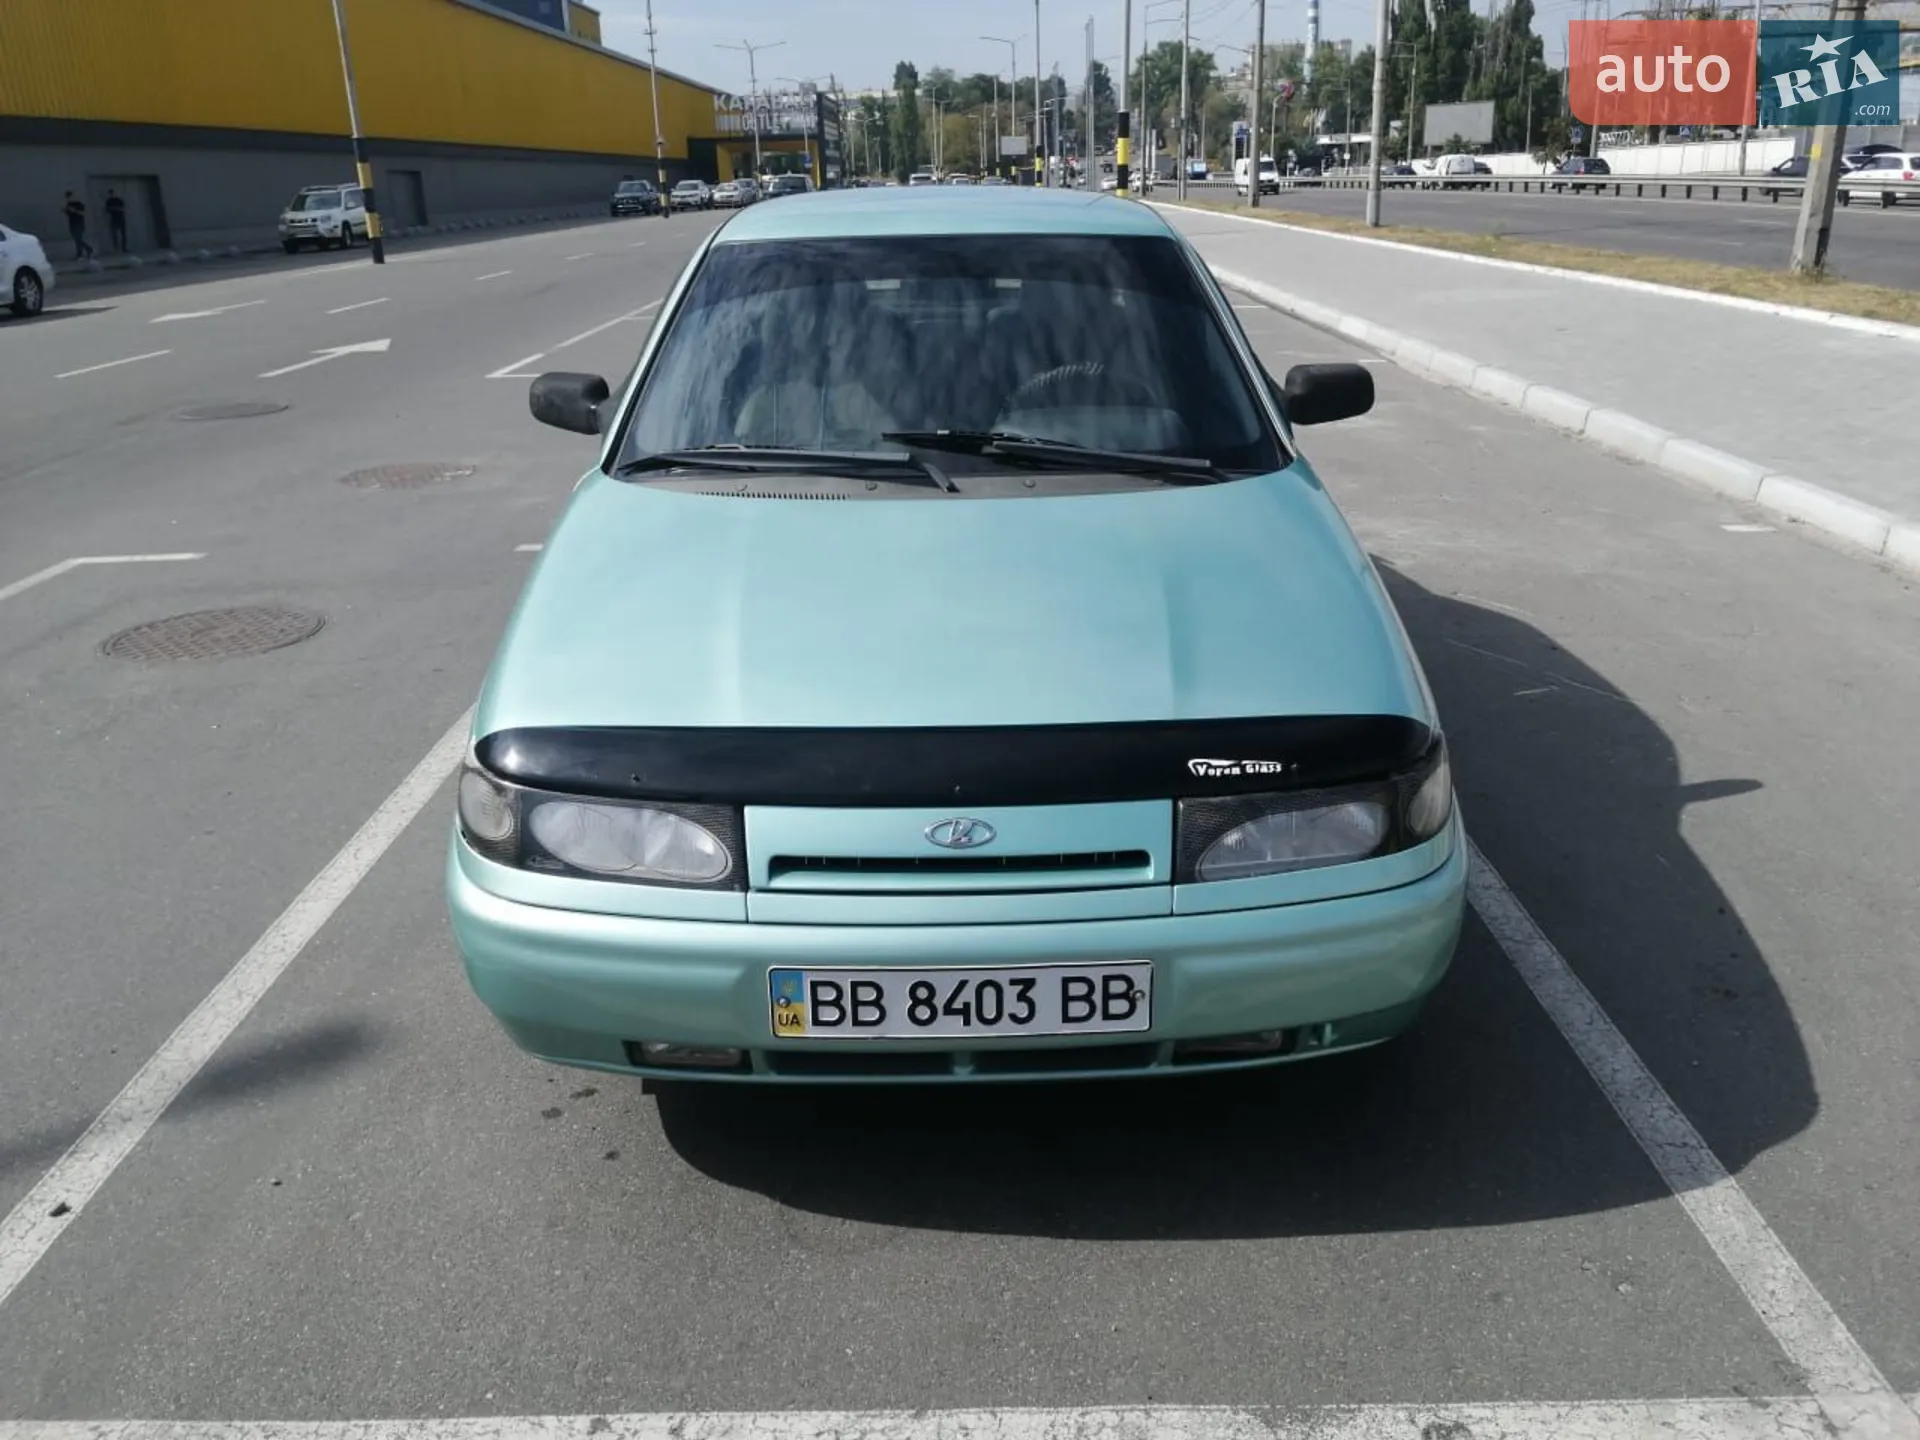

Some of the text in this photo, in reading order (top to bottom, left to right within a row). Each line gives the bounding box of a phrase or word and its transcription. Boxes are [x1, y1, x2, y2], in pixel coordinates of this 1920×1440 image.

[809, 973, 1138, 1027] BB 8403 BB
[777, 1014, 801, 1027] UA
